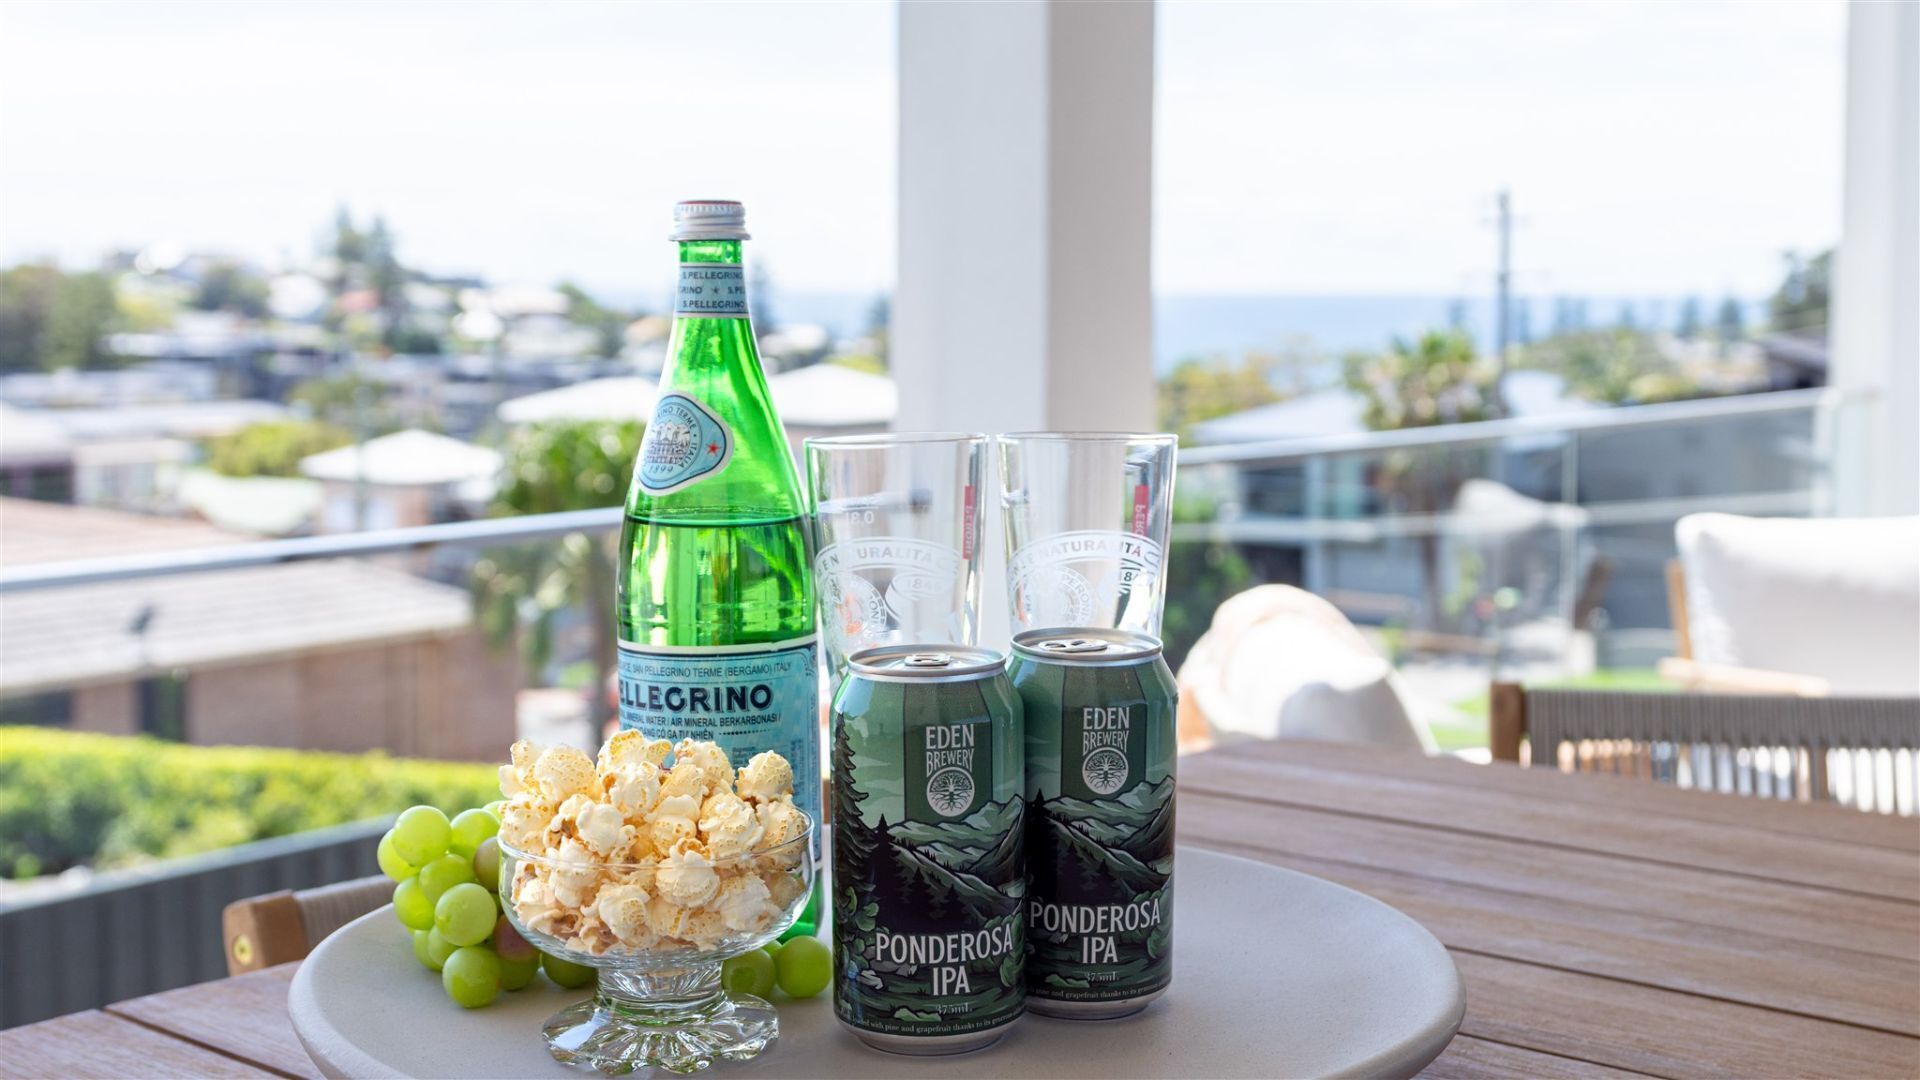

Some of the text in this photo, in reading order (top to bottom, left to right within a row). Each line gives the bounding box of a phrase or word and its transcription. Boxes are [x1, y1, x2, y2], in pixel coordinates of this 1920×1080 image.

[645, 665, 691, 677] PELLEGRINO
[693, 667, 722, 677] TERME
[725, 664, 772, 677] (BERGAMO)
[774, 662, 791, 671] ITALY
[670, 717, 682, 726] AIR
[684, 717, 717, 727] MINERAL
[1082, 707, 1130, 730] EDEN
[925, 724, 975, 750] EDEN
[1082, 730, 1130, 756] BREWERY
[925, 748, 975, 777] BREWERY
[1030, 898, 1161, 934] PONDEROSA
[875, 923, 1014, 965] PONDEROSA
[1082, 936, 1119, 964] IPA
[932, 965, 972, 996] IPA
[916, 1025, 951, 1034] grapefruit
